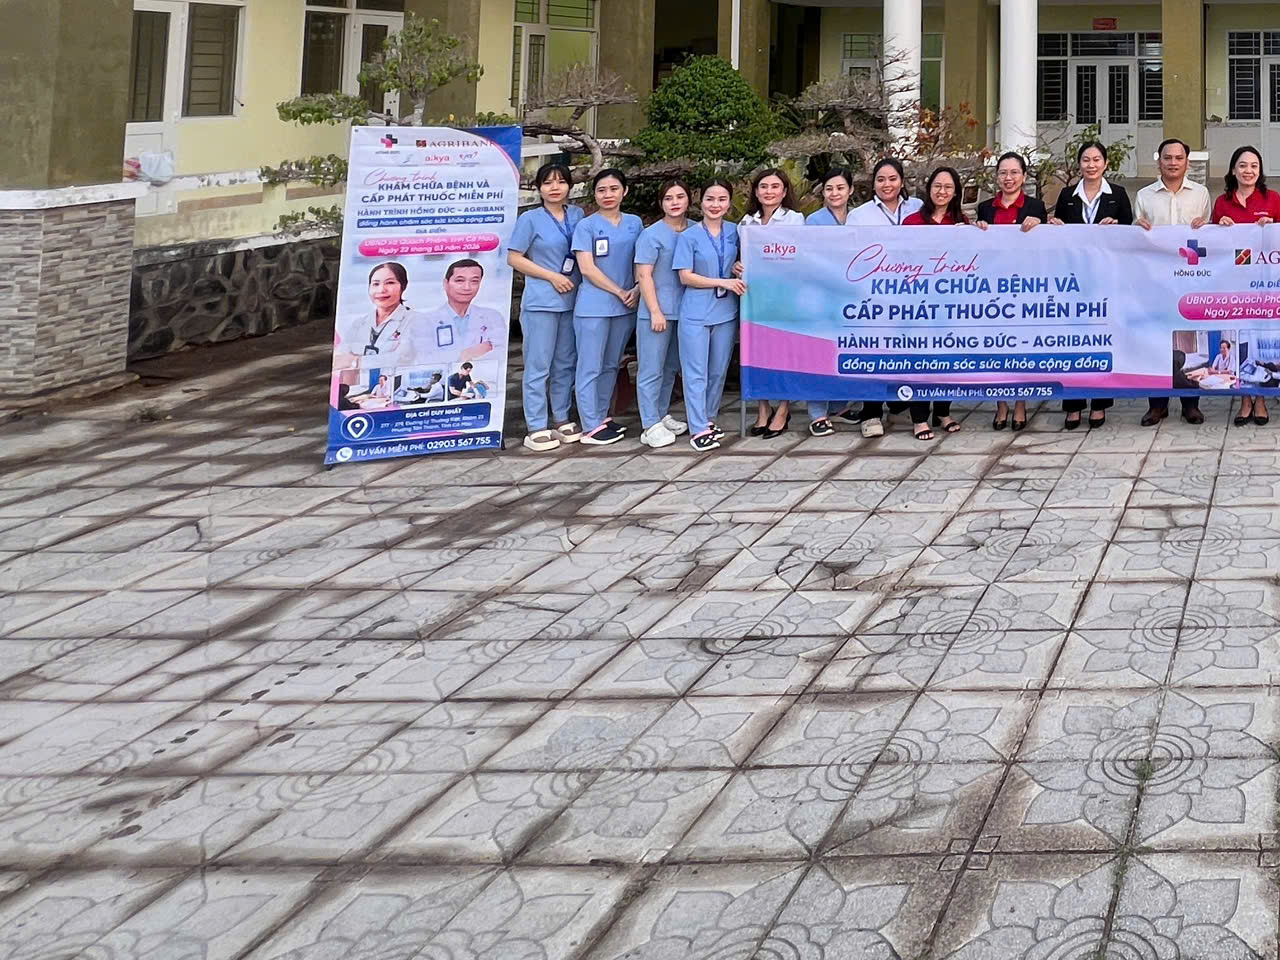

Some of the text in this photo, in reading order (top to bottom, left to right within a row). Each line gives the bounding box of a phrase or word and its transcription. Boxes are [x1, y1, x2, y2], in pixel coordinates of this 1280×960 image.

[378, 178, 490, 192] KHÁM CHỮA BỆNH VÀ
[361, 189, 504, 203] CẤP PHÁT THUỐC MIỄN PHÍ
[845, 243, 980, 284] Chương trình
[871, 272, 1081, 299] KHÁM CHỮA BỆNH VÀ
[1249, 280, 1266, 290] ĐỊA
[1186, 295, 1215, 305] UBND
[1229, 294, 1263, 304] Quách
[842, 294, 1109, 321] CẤP PHÁT THUỐC MIỄN PHÍ
[1204, 307, 1231, 319] Ngày
[1231, 306, 1244, 317] 22
[1244, 306, 1275, 318] tháng
[837, 332, 880, 349] HÀNH
[883, 333, 929, 349] TRÌNH
[983, 331, 1018, 349] ĐỨC
[1032, 333, 1113, 348] AGRIBANK
[878, 358, 912, 371] hành
[913, 358, 951, 371] chăm
[952, 358, 977, 371] sóc
[979, 358, 1002, 370] sức
[1003, 357, 1037, 370] khỏe
[1038, 358, 1072, 372] cộng
[916, 387, 929, 397] TƯ
[929, 386, 947, 397] VẤN
[985, 387, 1016, 398] 02903
[1017, 387, 1034, 397] 567
[1035, 386, 1054, 397] 755
[426, 439, 456, 450] 02903
[457, 437, 475, 447] 567
[475, 436, 492, 445] 755
